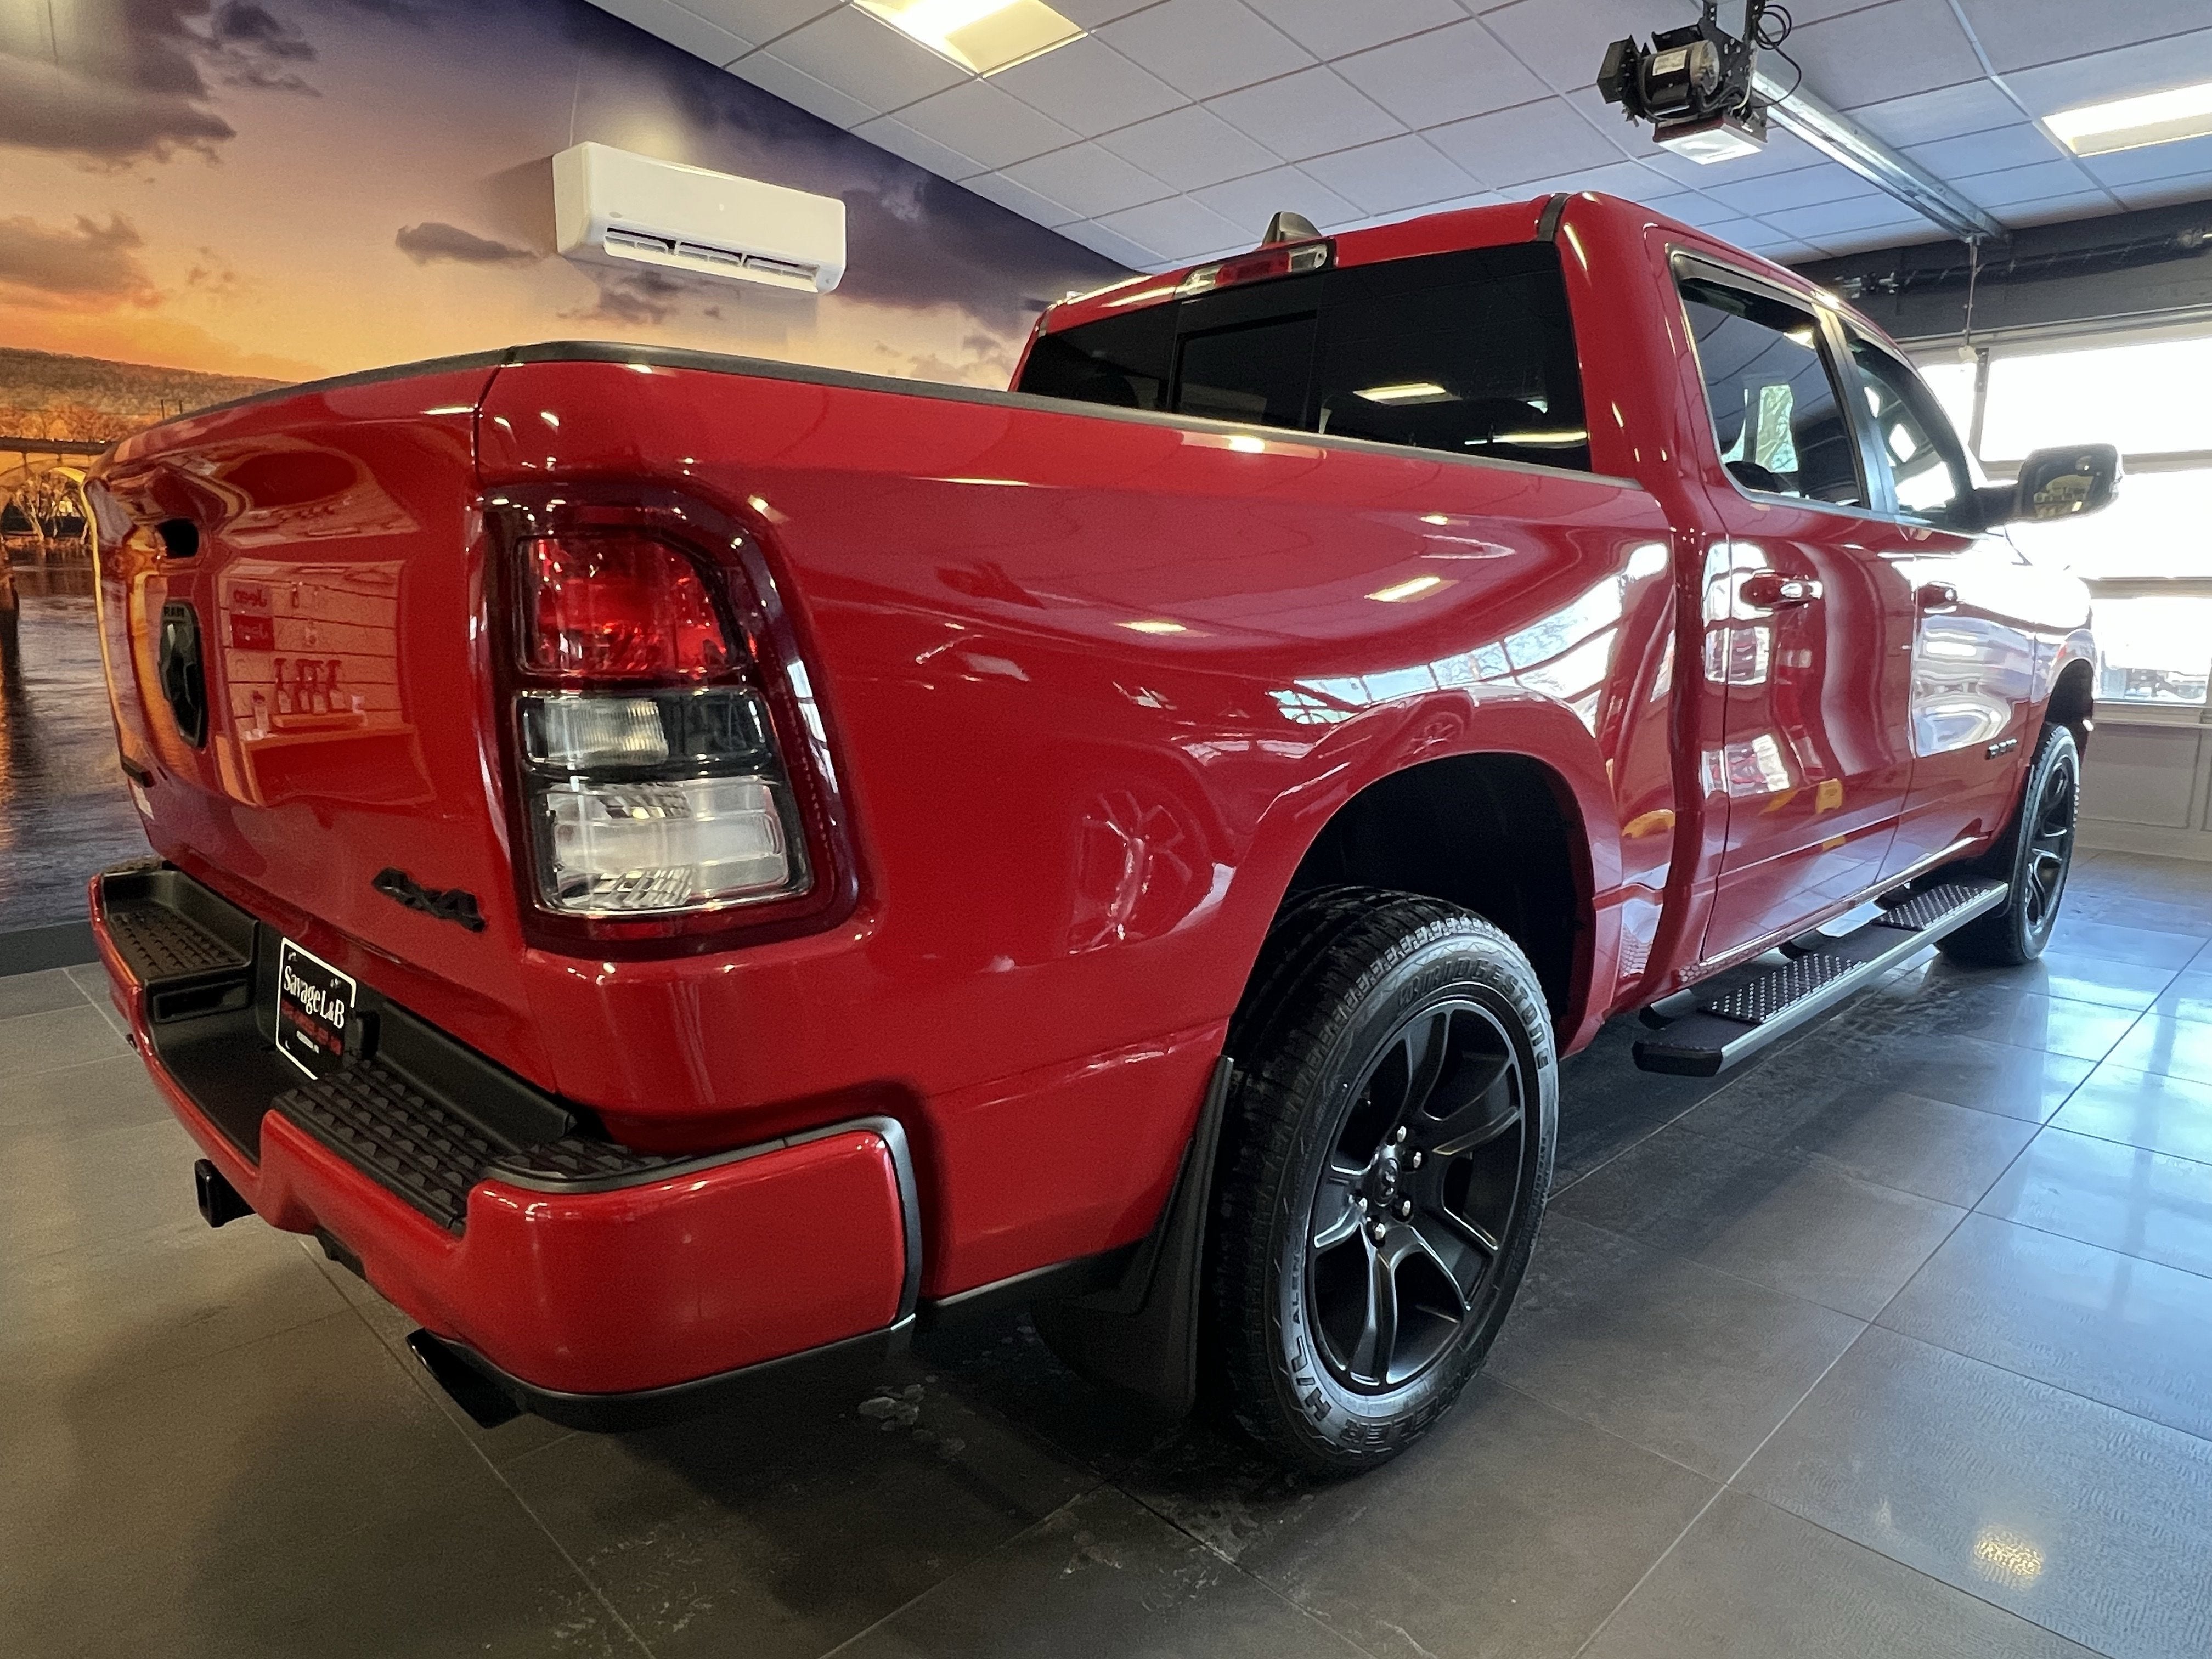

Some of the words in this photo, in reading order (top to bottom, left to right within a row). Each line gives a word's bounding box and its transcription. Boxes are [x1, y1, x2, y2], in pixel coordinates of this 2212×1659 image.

[284, 966, 320, 1015] Savage
[1398, 957, 1548, 1070] BRIDGESTONE
[1292, 1336, 1332, 1421] H/L
